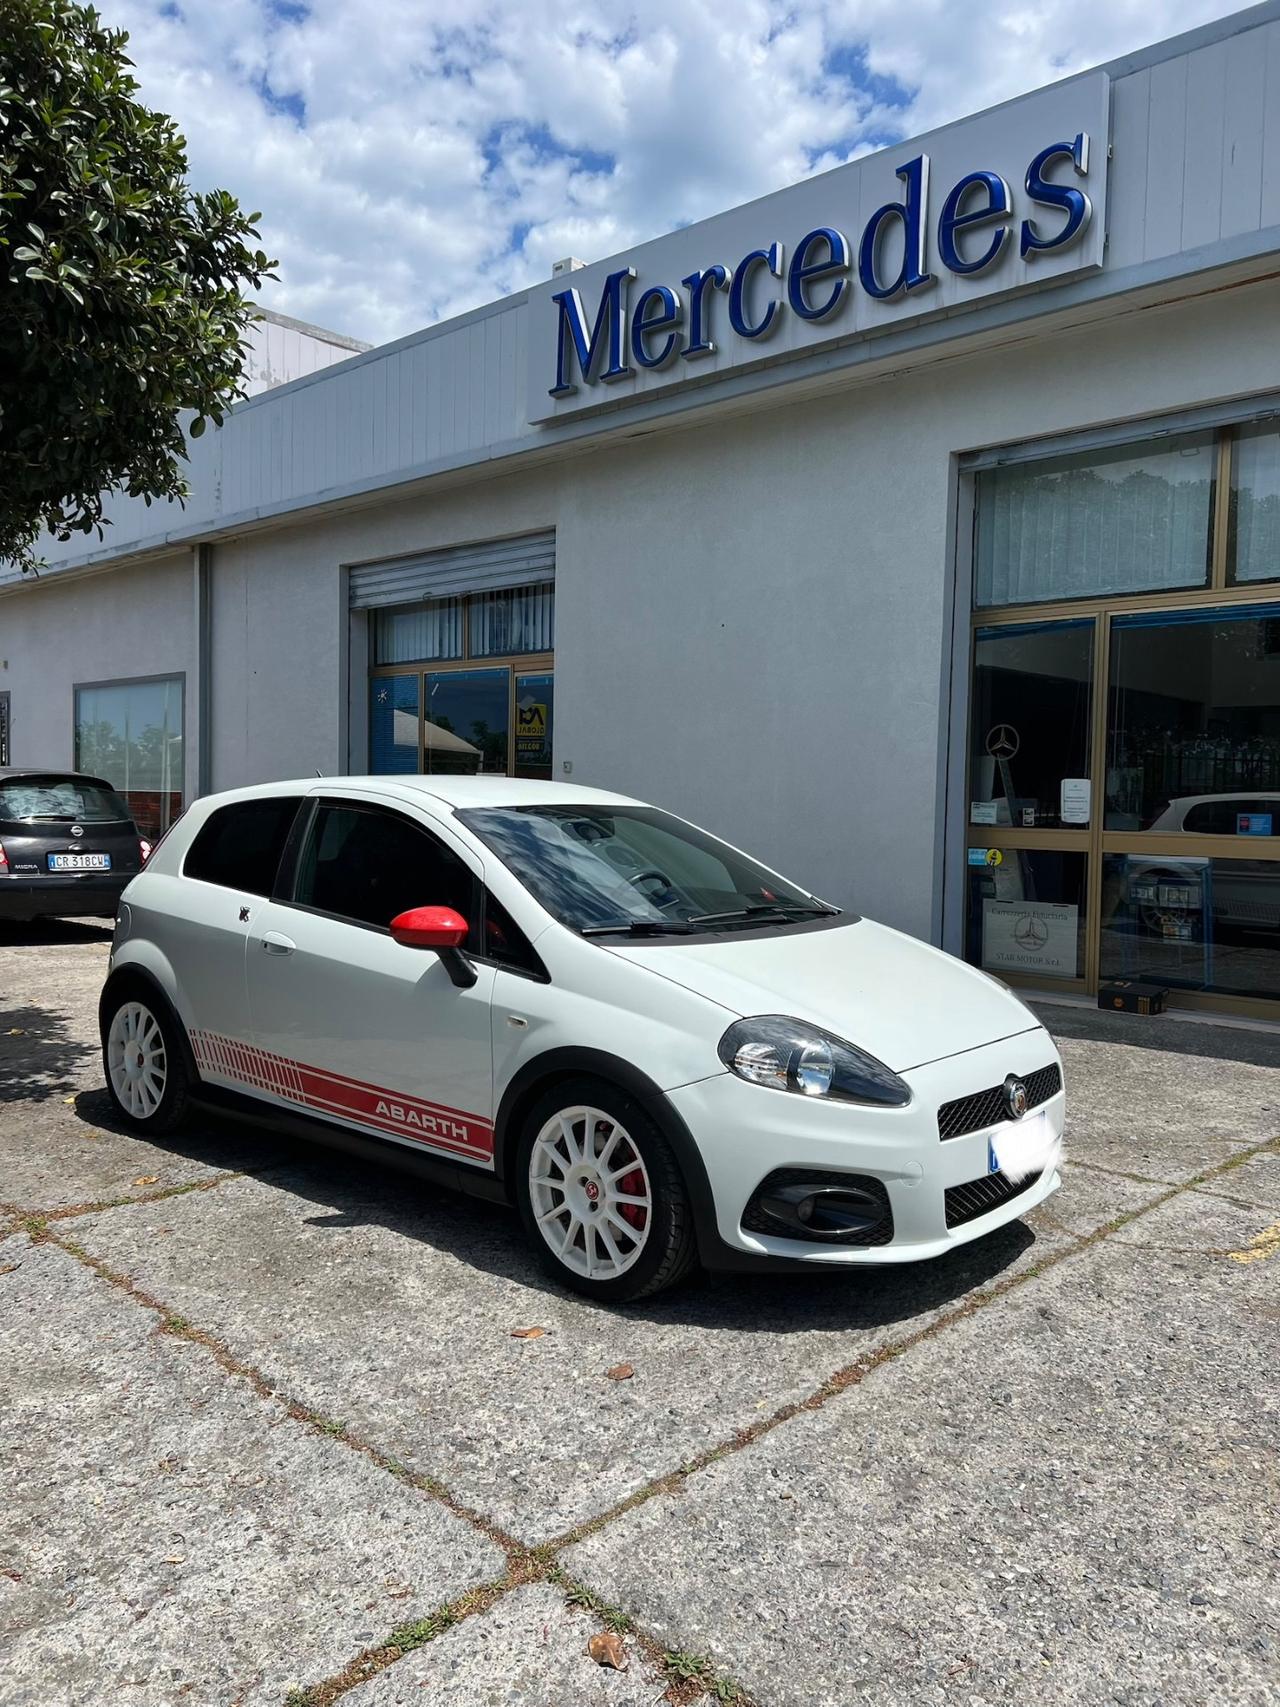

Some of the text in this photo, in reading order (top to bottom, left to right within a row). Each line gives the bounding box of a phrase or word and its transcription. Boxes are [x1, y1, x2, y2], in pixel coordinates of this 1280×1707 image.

[548, 131, 1093, 398] Mercedes
[56, 855, 104, 867] CR 318CW
[1016, 954, 1044, 964] MOTOR
[375, 1100, 469, 1141] ABARTH
